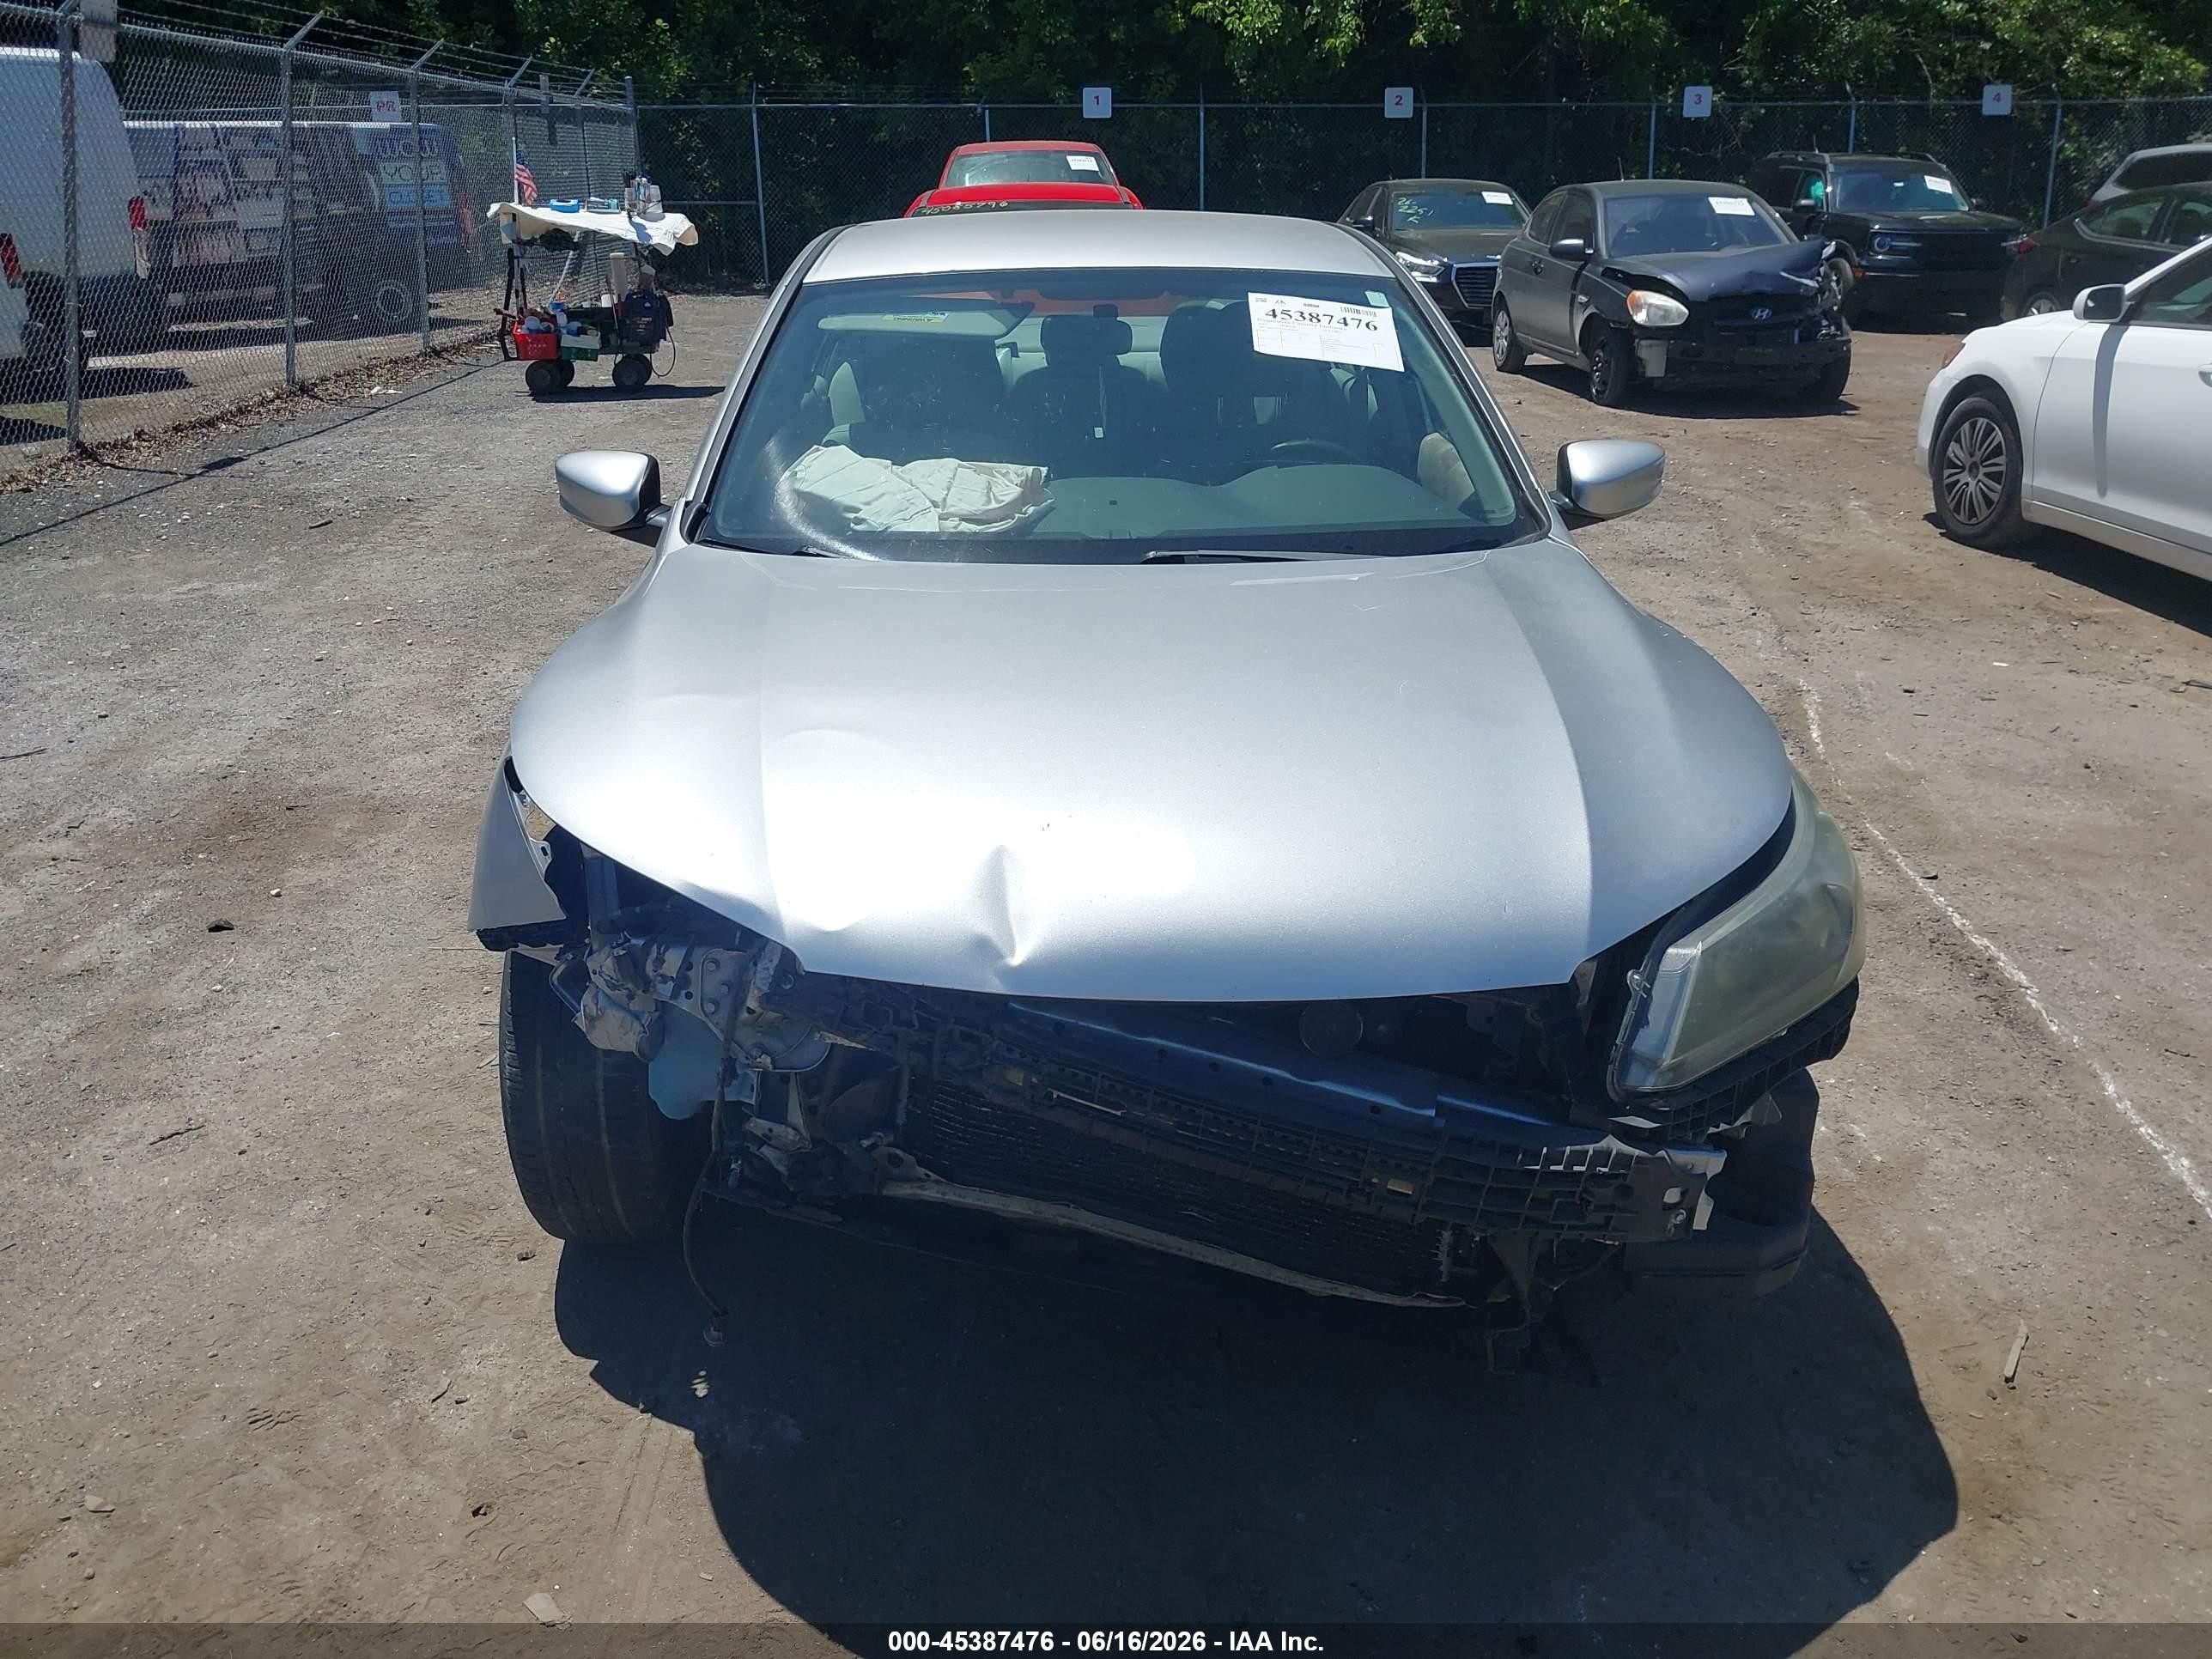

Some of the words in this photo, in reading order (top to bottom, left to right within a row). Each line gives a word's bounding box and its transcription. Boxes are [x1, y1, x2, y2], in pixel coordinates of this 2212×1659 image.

[1093, 94, 1100, 106] 1
[1394, 94, 1403, 106] 2
[1693, 94, 1702, 105] 3
[1992, 93, 2002, 103] 4
[376, 100, 396, 112] PR
[1265, 308, 1378, 331] 45387476
